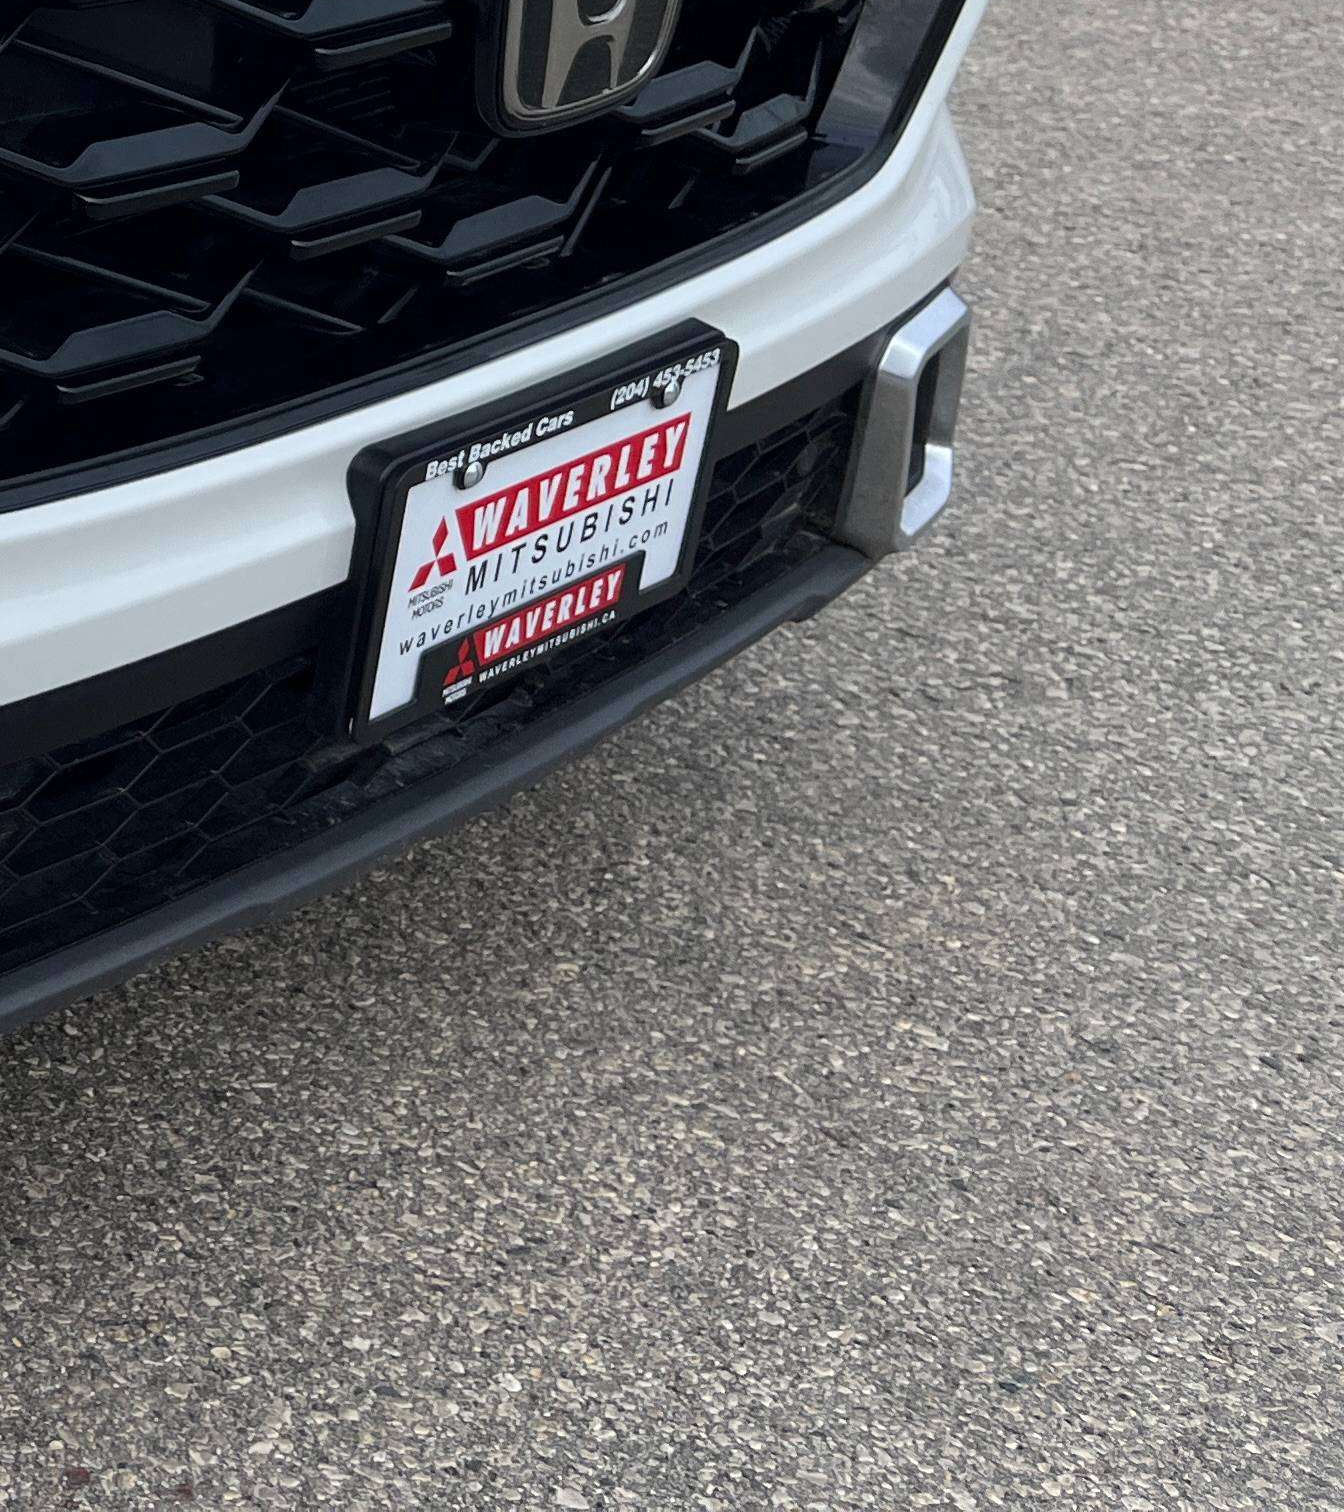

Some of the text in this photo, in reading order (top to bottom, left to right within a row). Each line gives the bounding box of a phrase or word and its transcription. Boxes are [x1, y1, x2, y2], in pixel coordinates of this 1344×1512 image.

[610, 376, 650, 411] (204)
[425, 410, 575, 481] Best Backed Cars
[472, 421, 687, 552] WAVERLEY
[465, 478, 675, 597] MITSUBISHI
[399, 519, 669, 657] waverleymitsubishi.com
[483, 569, 623, 660] WAVERLEY
[478, 609, 616, 684] WAVERLEYMITSUBISHI.CA
